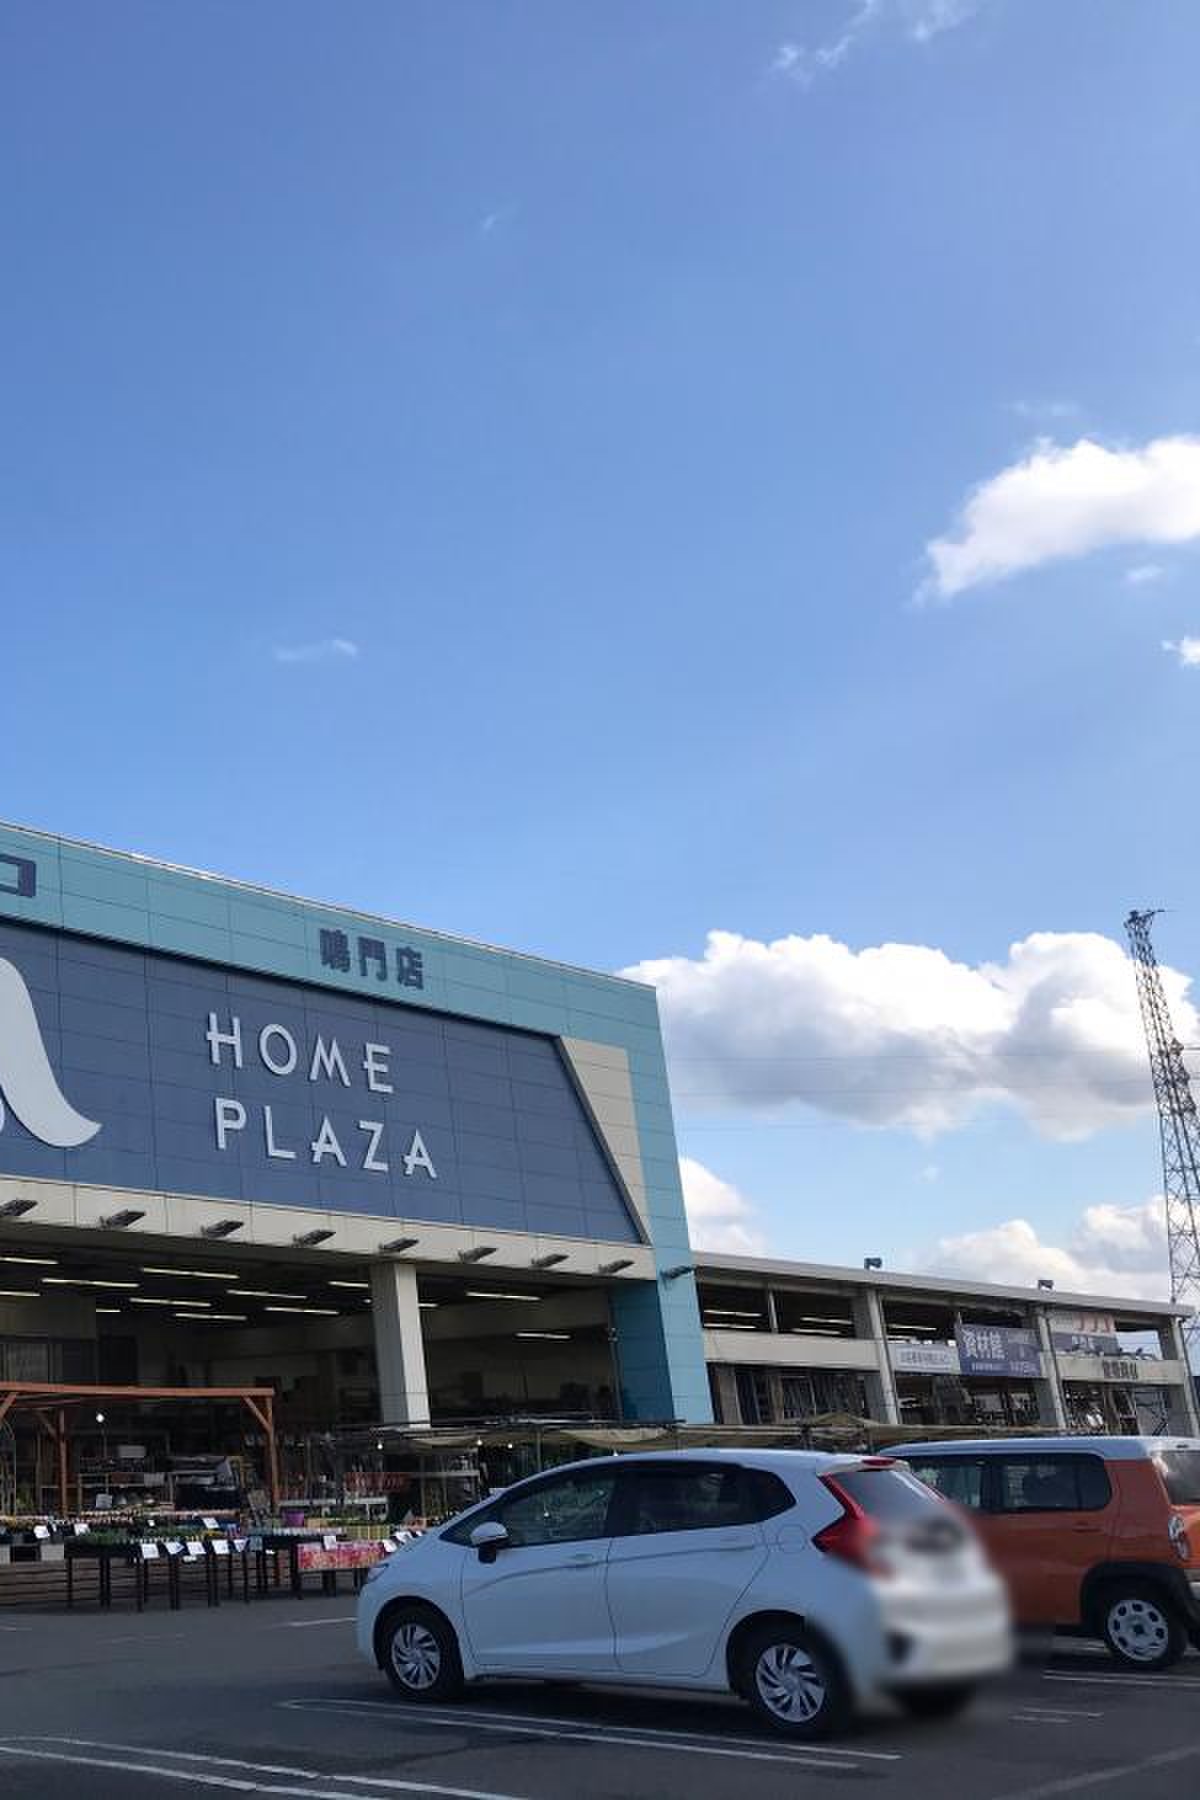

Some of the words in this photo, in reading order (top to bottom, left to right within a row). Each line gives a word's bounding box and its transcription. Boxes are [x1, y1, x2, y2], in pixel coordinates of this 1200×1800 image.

[319, 928, 424, 990] 鳴門店
[206, 1012, 394, 1093] HOME
[215, 1097, 437, 1179] PLAZA
